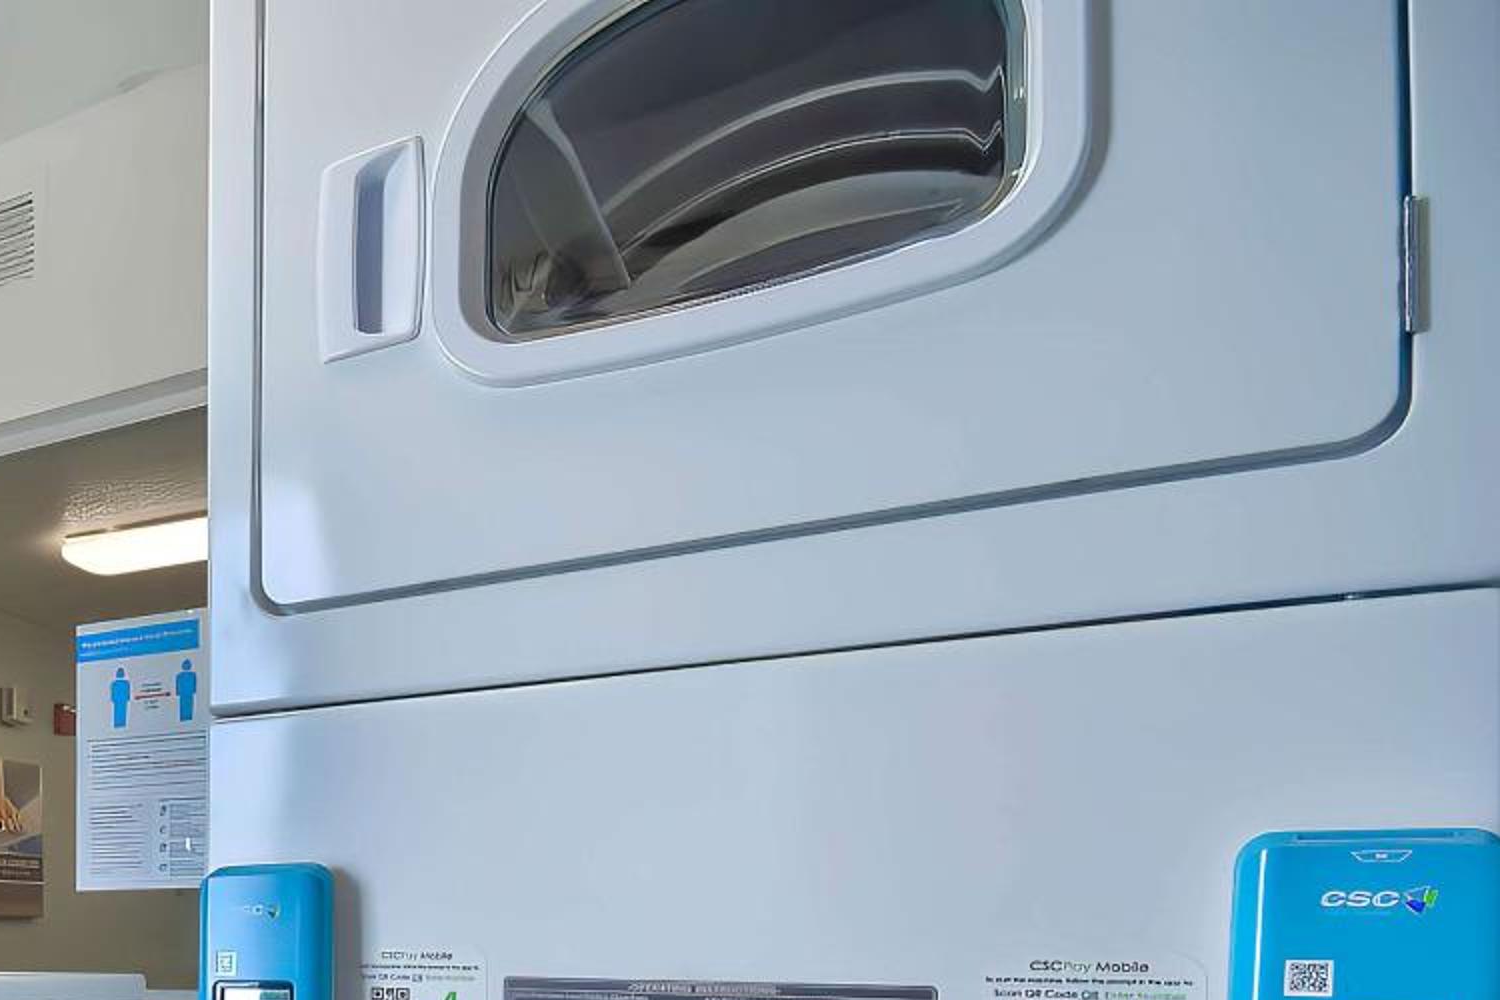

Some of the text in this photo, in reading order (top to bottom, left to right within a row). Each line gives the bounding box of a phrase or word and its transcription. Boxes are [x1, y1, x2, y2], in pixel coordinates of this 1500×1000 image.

[1319, 890, 1400, 908] CSC
[1029, 960, 1150, 973] CSCPay Mobile
